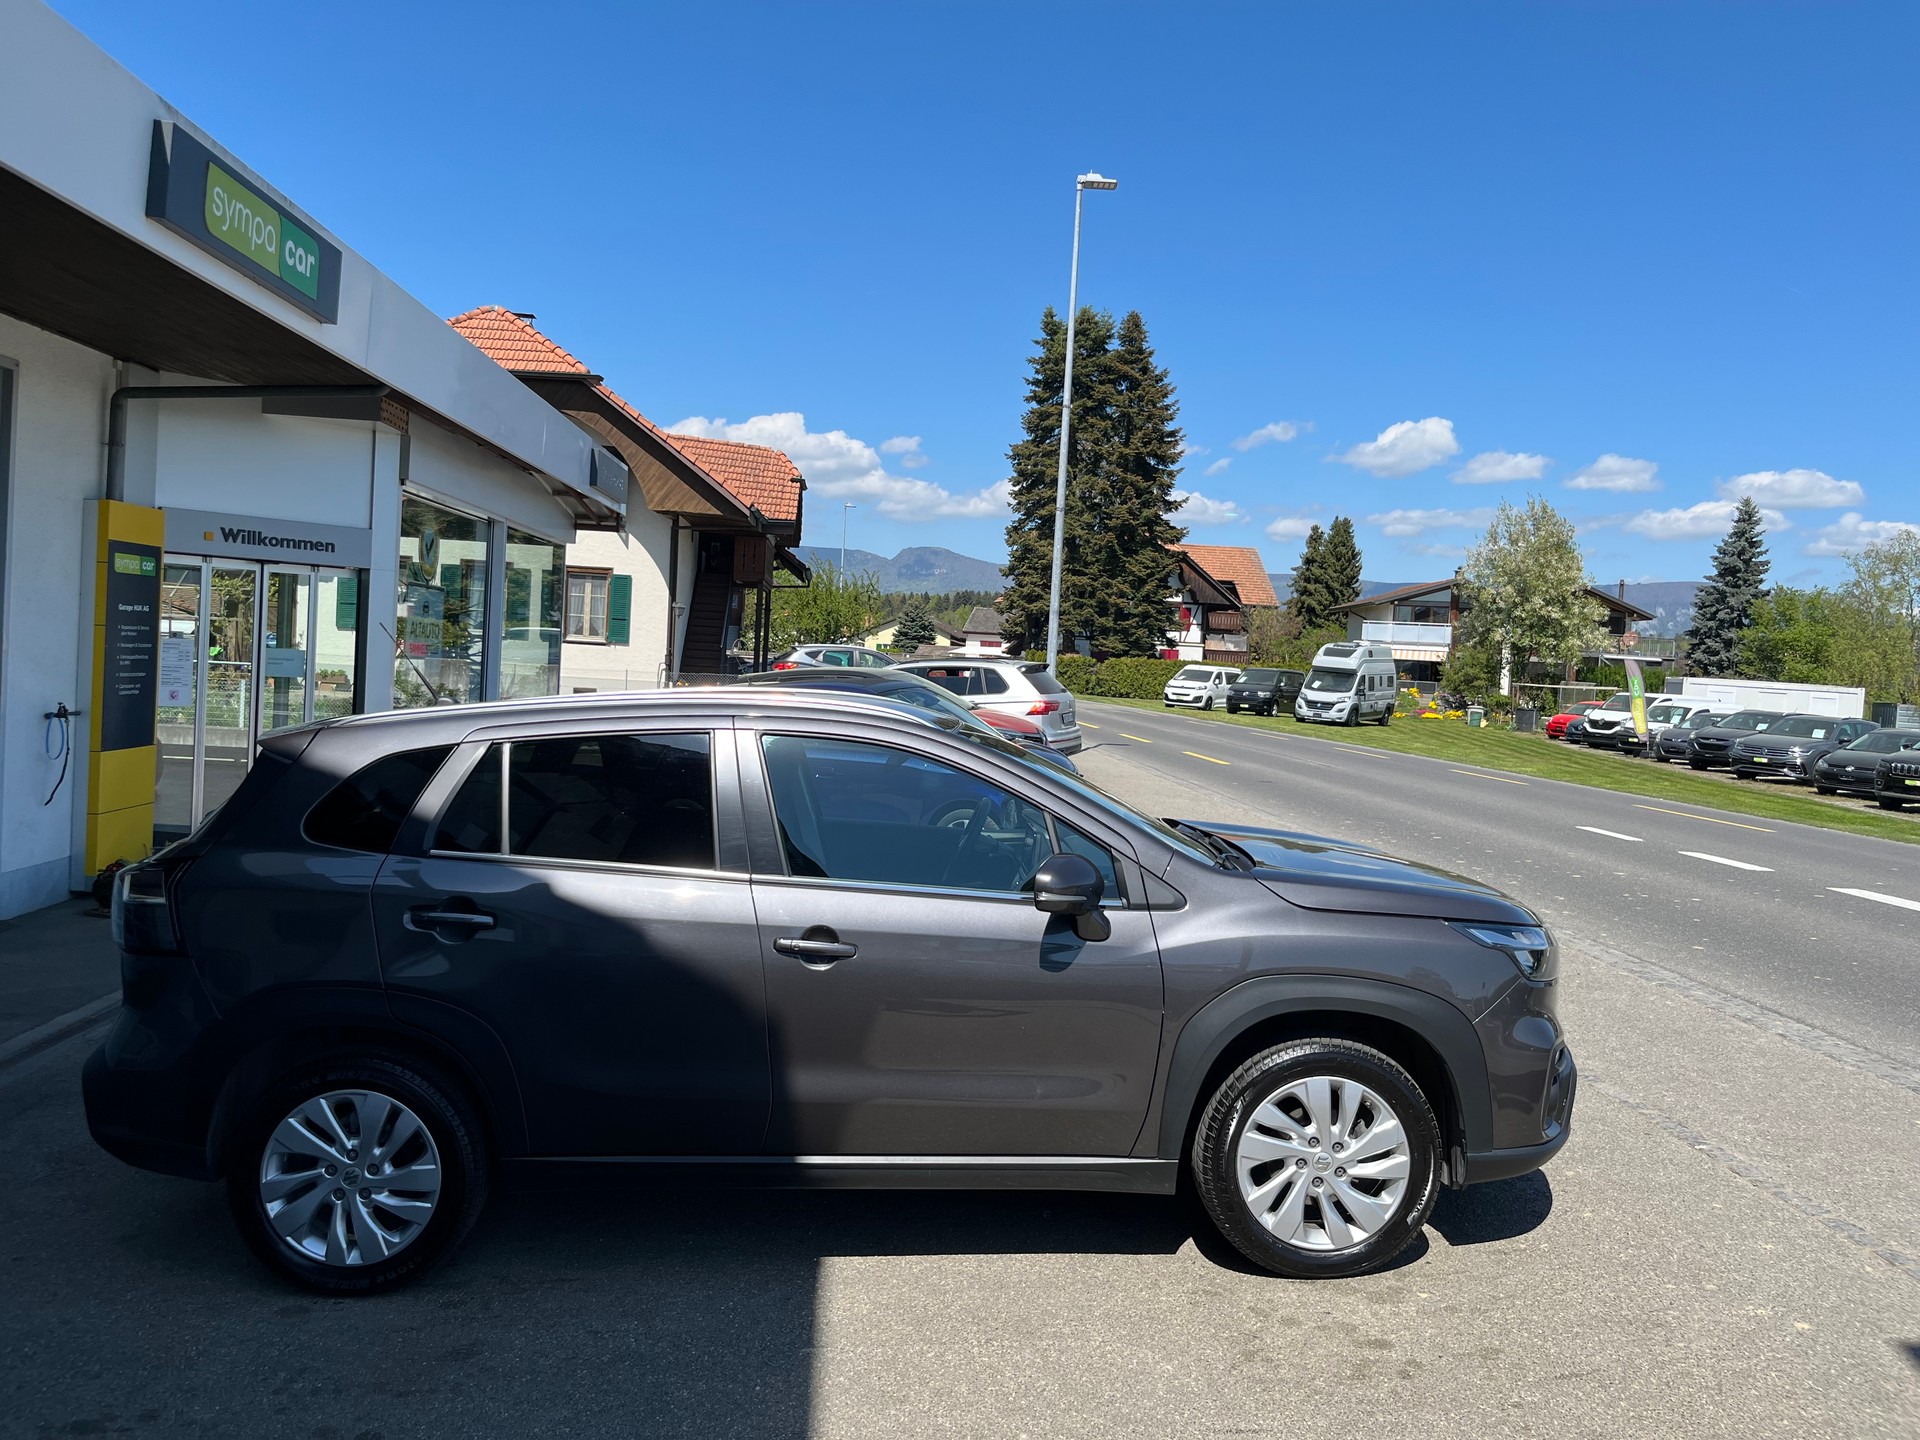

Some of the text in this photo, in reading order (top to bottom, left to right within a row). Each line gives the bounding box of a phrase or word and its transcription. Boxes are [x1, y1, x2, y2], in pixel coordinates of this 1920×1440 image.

[212, 186, 315, 278] sympa car
[220, 526, 336, 553] Willkommen
[116, 558, 155, 571] sympa car
